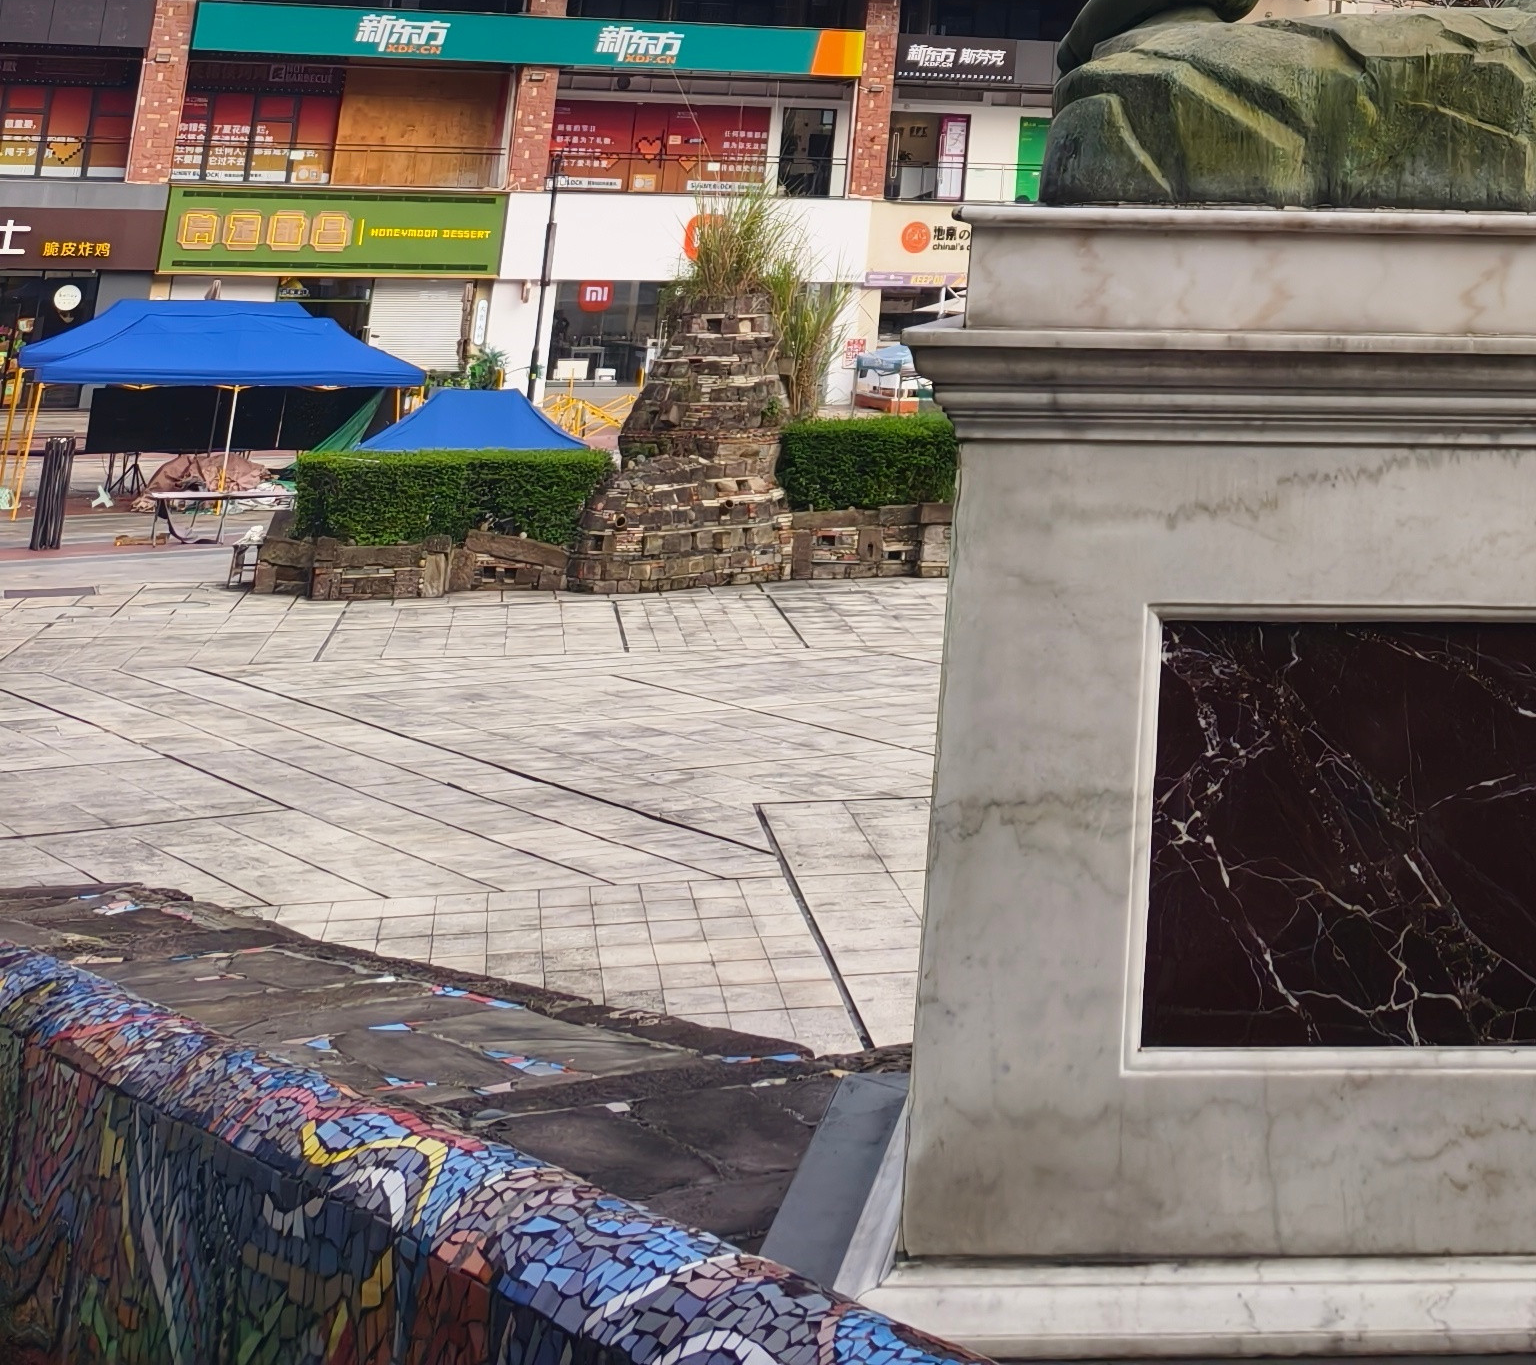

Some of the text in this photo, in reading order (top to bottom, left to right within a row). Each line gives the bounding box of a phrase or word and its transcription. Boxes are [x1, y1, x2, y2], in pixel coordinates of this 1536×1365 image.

[355, 14, 451, 52] 新东方
[596, 26, 685, 62] 新东方
[624, 54, 677, 64] XDF.CN
[906, 44, 1007, 67] 新东方 斯芬克
[371, 228, 491, 239] HONEYMOON DESSERT
[42, 241, 111, 258] 脆皮炸鸡
